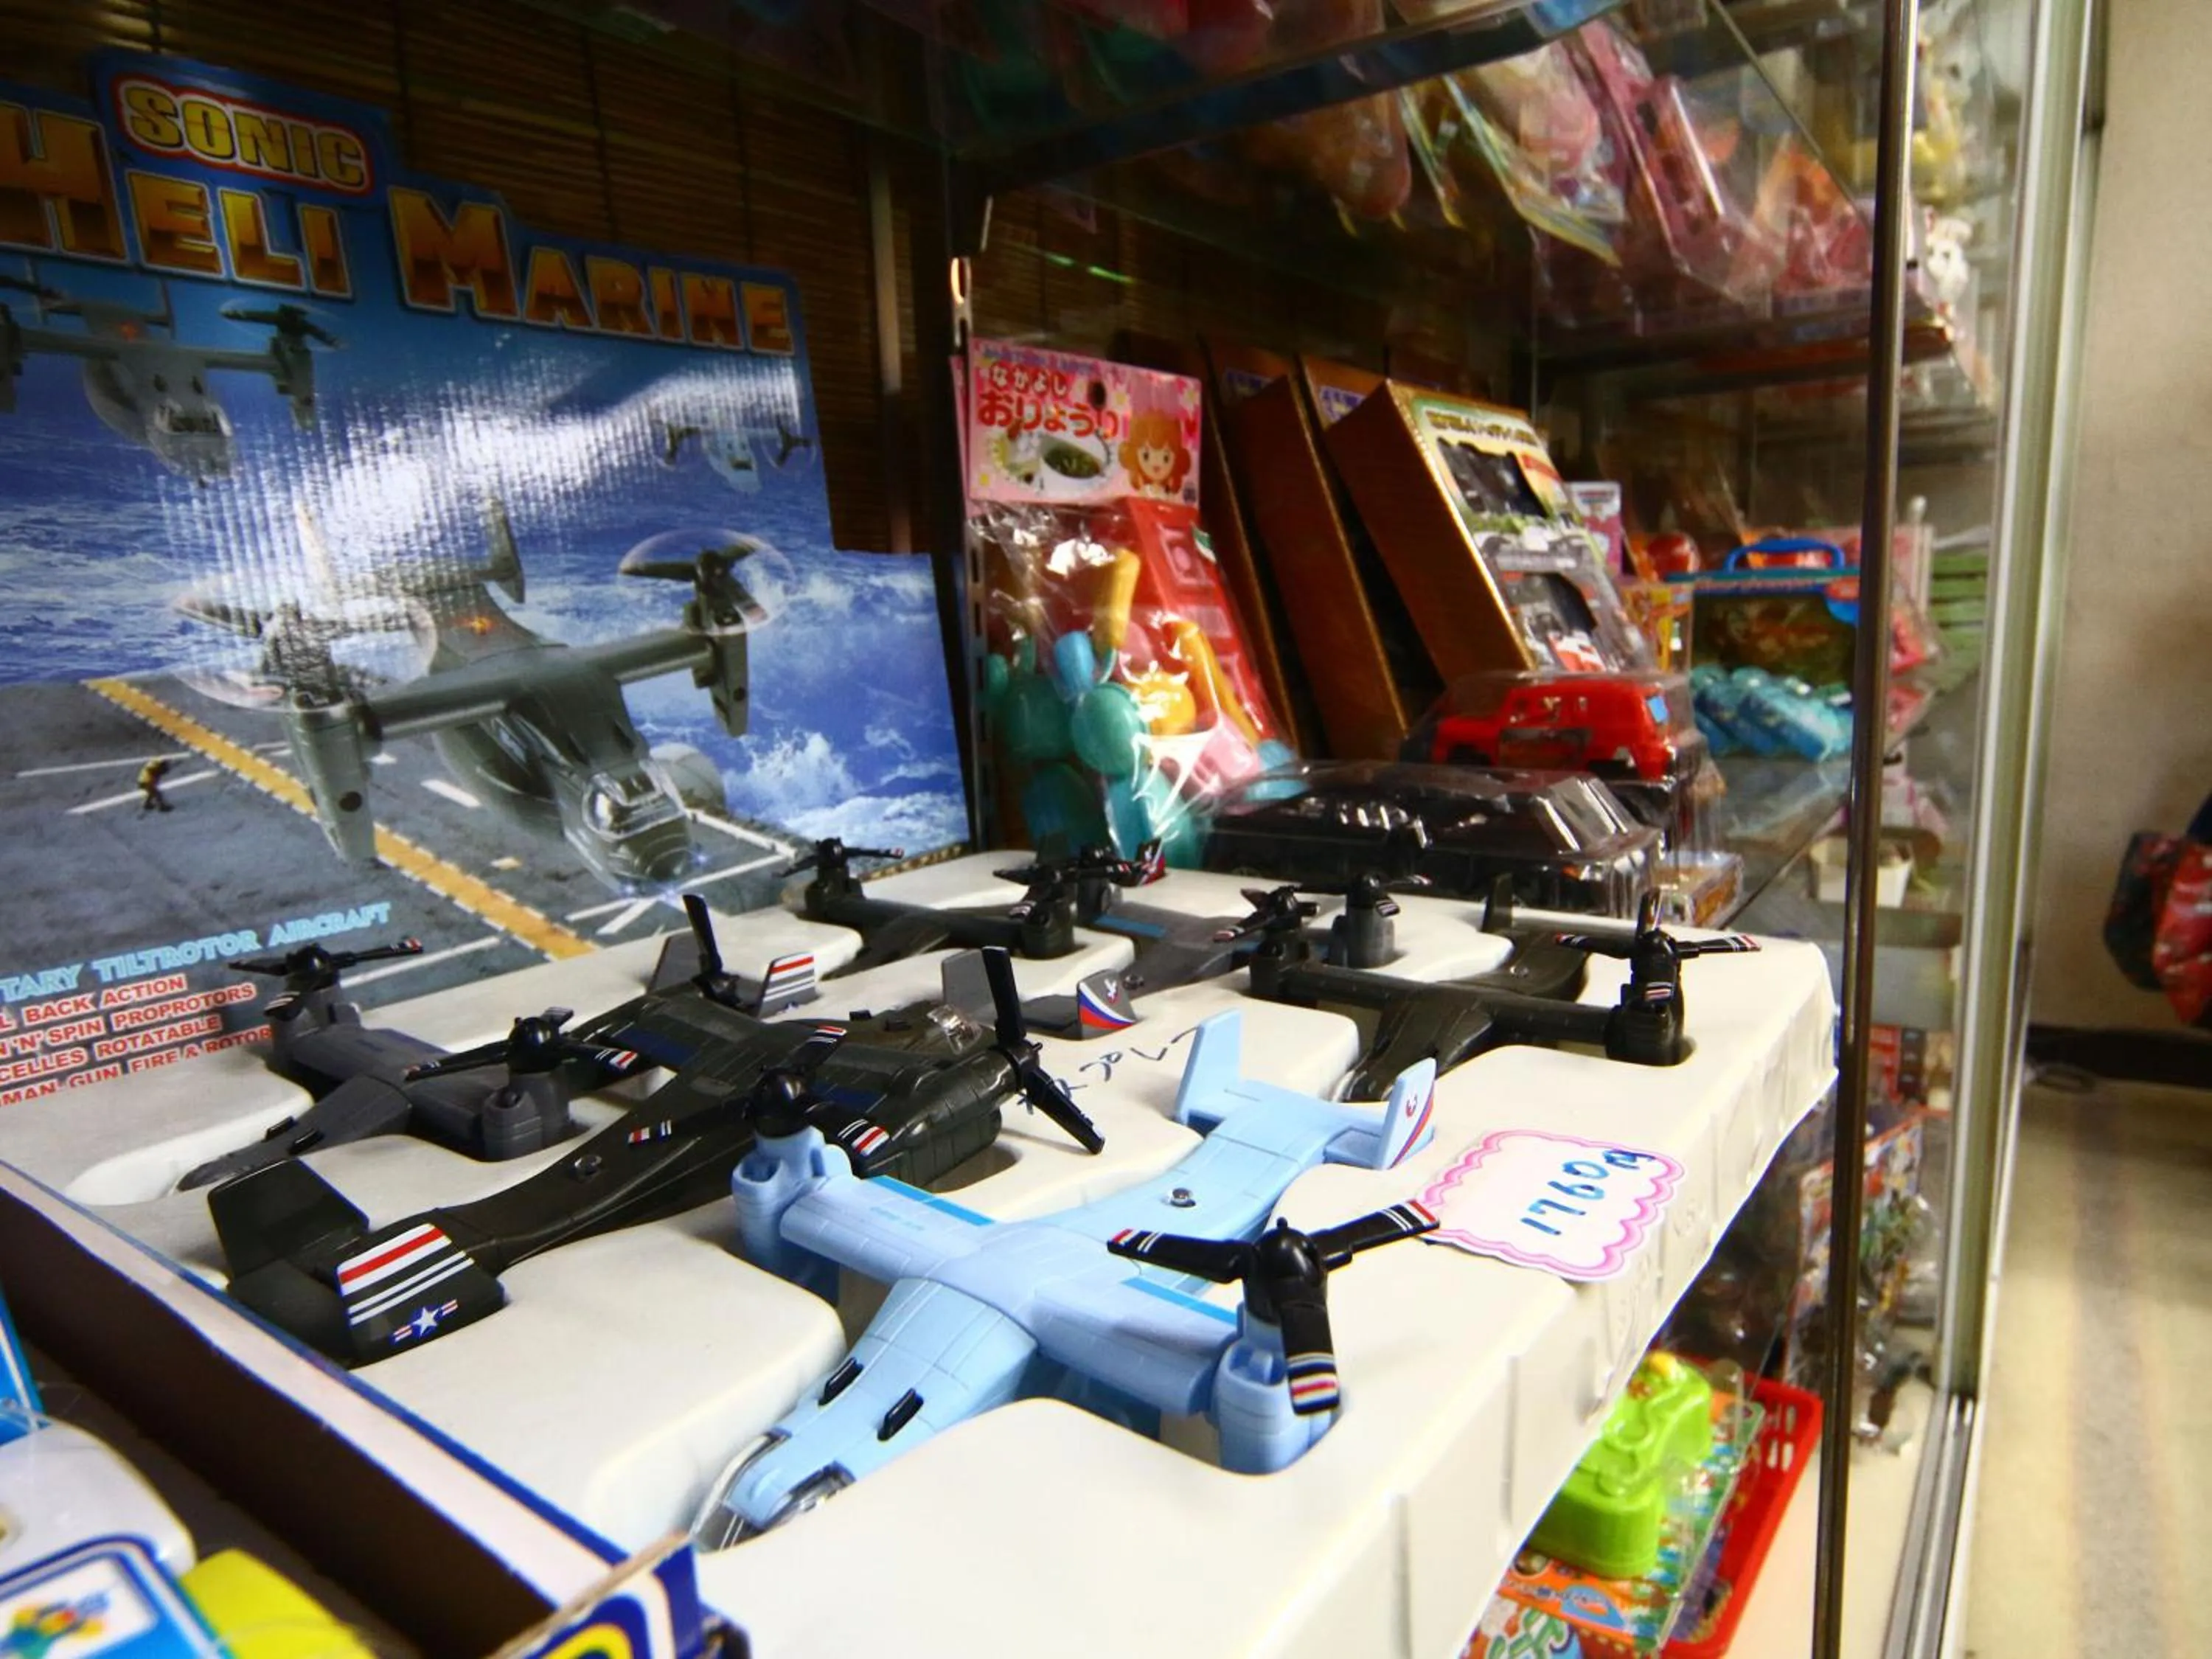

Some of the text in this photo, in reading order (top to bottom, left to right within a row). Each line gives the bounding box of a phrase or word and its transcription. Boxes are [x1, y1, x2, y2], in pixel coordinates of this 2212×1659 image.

[123, 83, 366, 189] SONIC
[389, 187, 794, 355] MARINE
[991, 364, 1068, 398] なかよし
[978, 390, 1119, 439] おりょうり
[94, 930, 261, 982] TILTROTOR
[268, 902, 391, 946] AIRCRAFT
[24, 995, 91, 1024] BACK
[103, 976, 185, 1006] ACTION
[48, 1019, 102, 1044] SPIN
[114, 984, 254, 1028] PROPROTORS
[97, 1015, 221, 1058] ROTATABLE
[131, 1050, 178, 1073] FIRE
[185, 1046, 199, 1059] &
